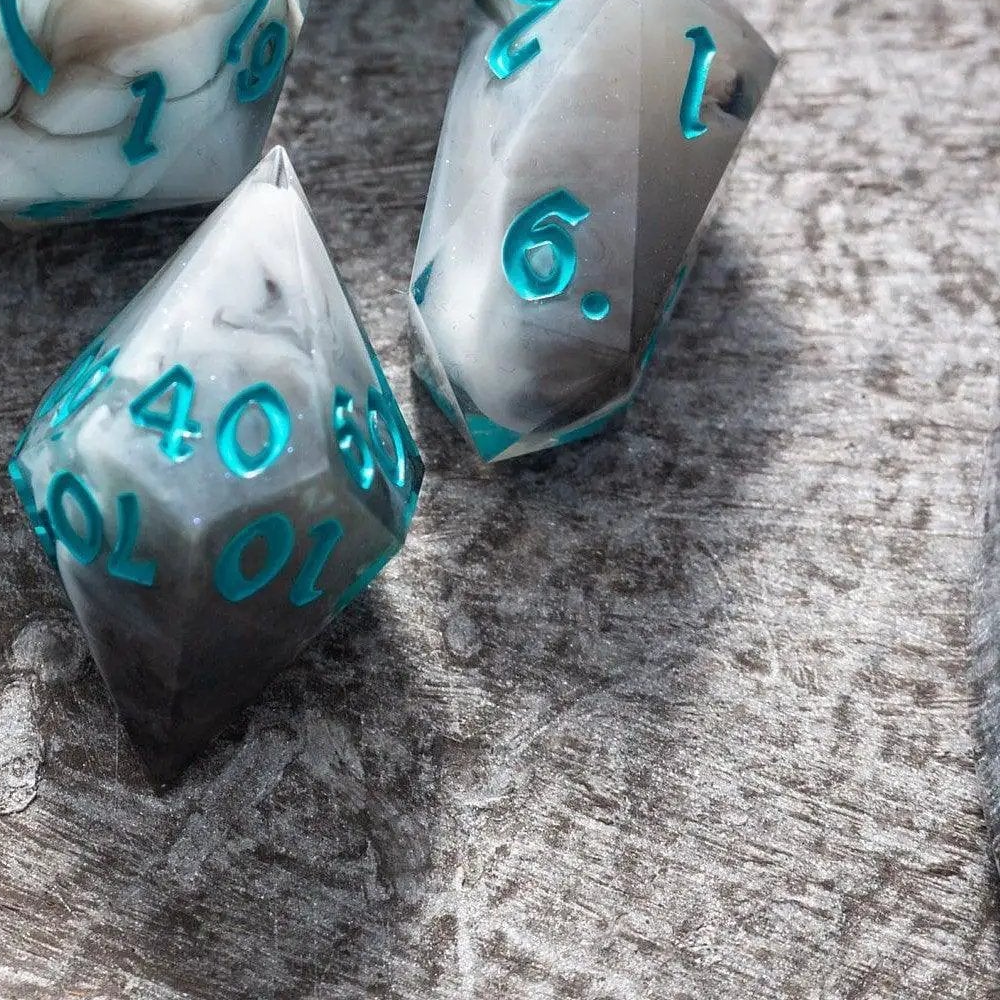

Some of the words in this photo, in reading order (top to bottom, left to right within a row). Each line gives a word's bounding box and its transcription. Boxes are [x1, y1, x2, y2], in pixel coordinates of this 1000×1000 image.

[119, 70, 167, 167] 1
[680, 25, 716, 141] 1
[128, 363, 293, 479] 40
[46, 469, 159, 587] 70
